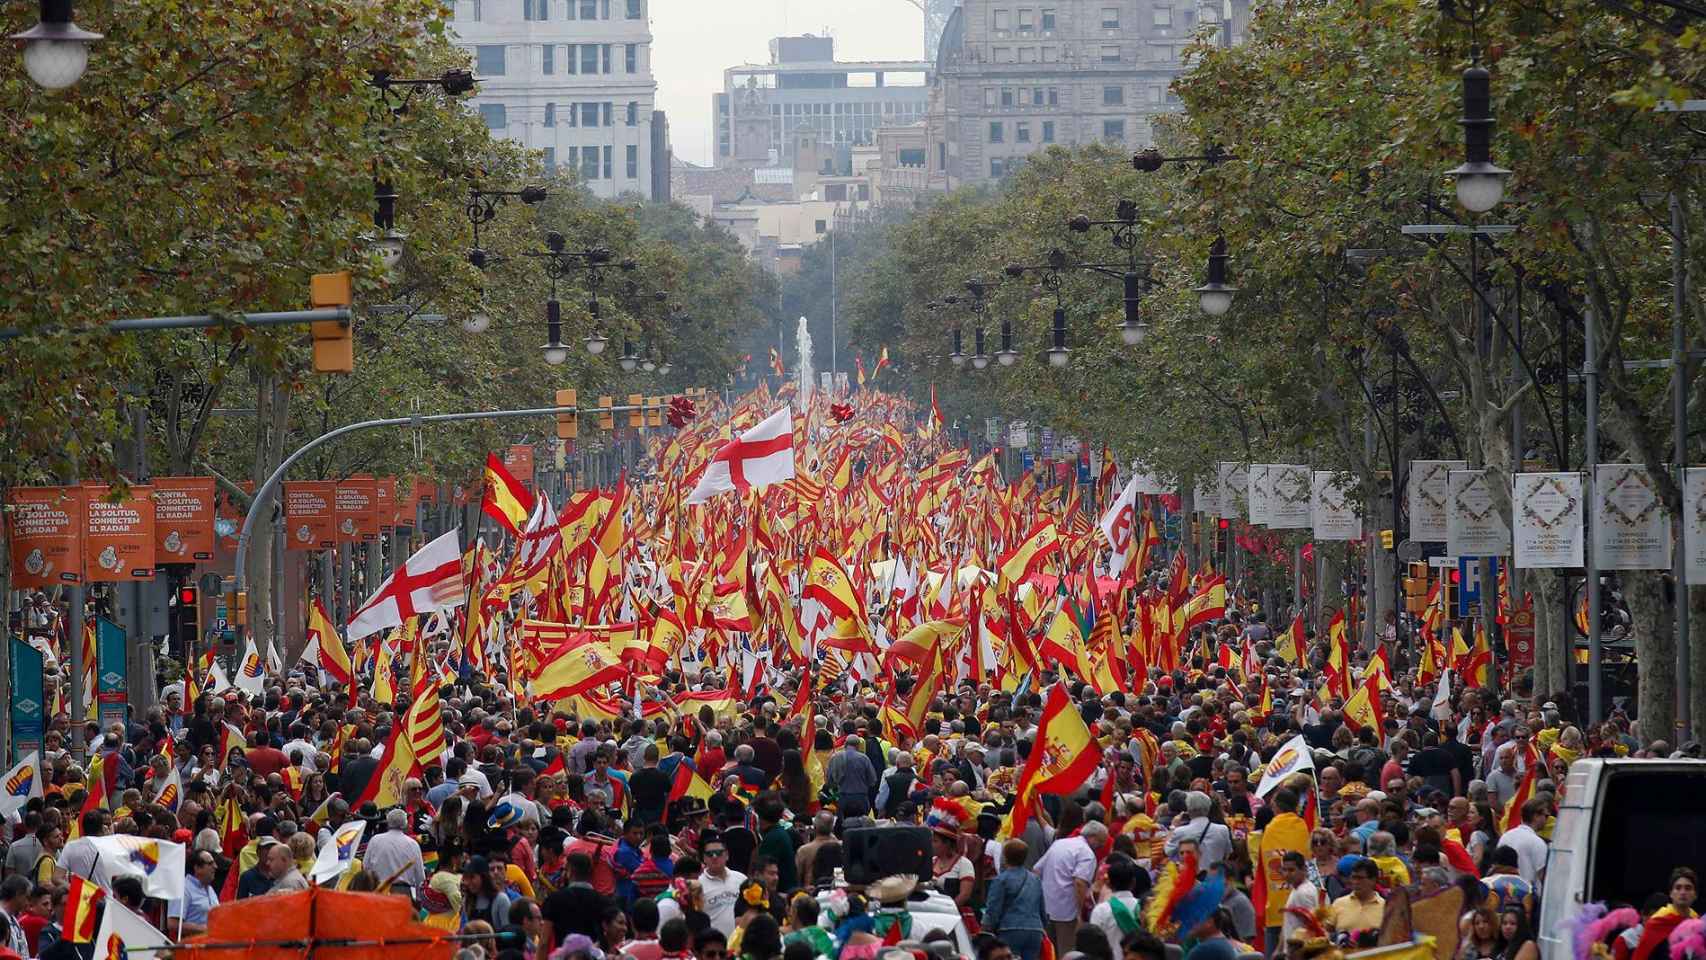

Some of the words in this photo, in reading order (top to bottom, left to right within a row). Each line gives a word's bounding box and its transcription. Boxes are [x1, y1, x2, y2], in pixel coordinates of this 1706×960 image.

[89, 517, 140, 525] CONNECTEM
[26, 526, 58, 534] RADAR
[219, 620, 226, 630] P
